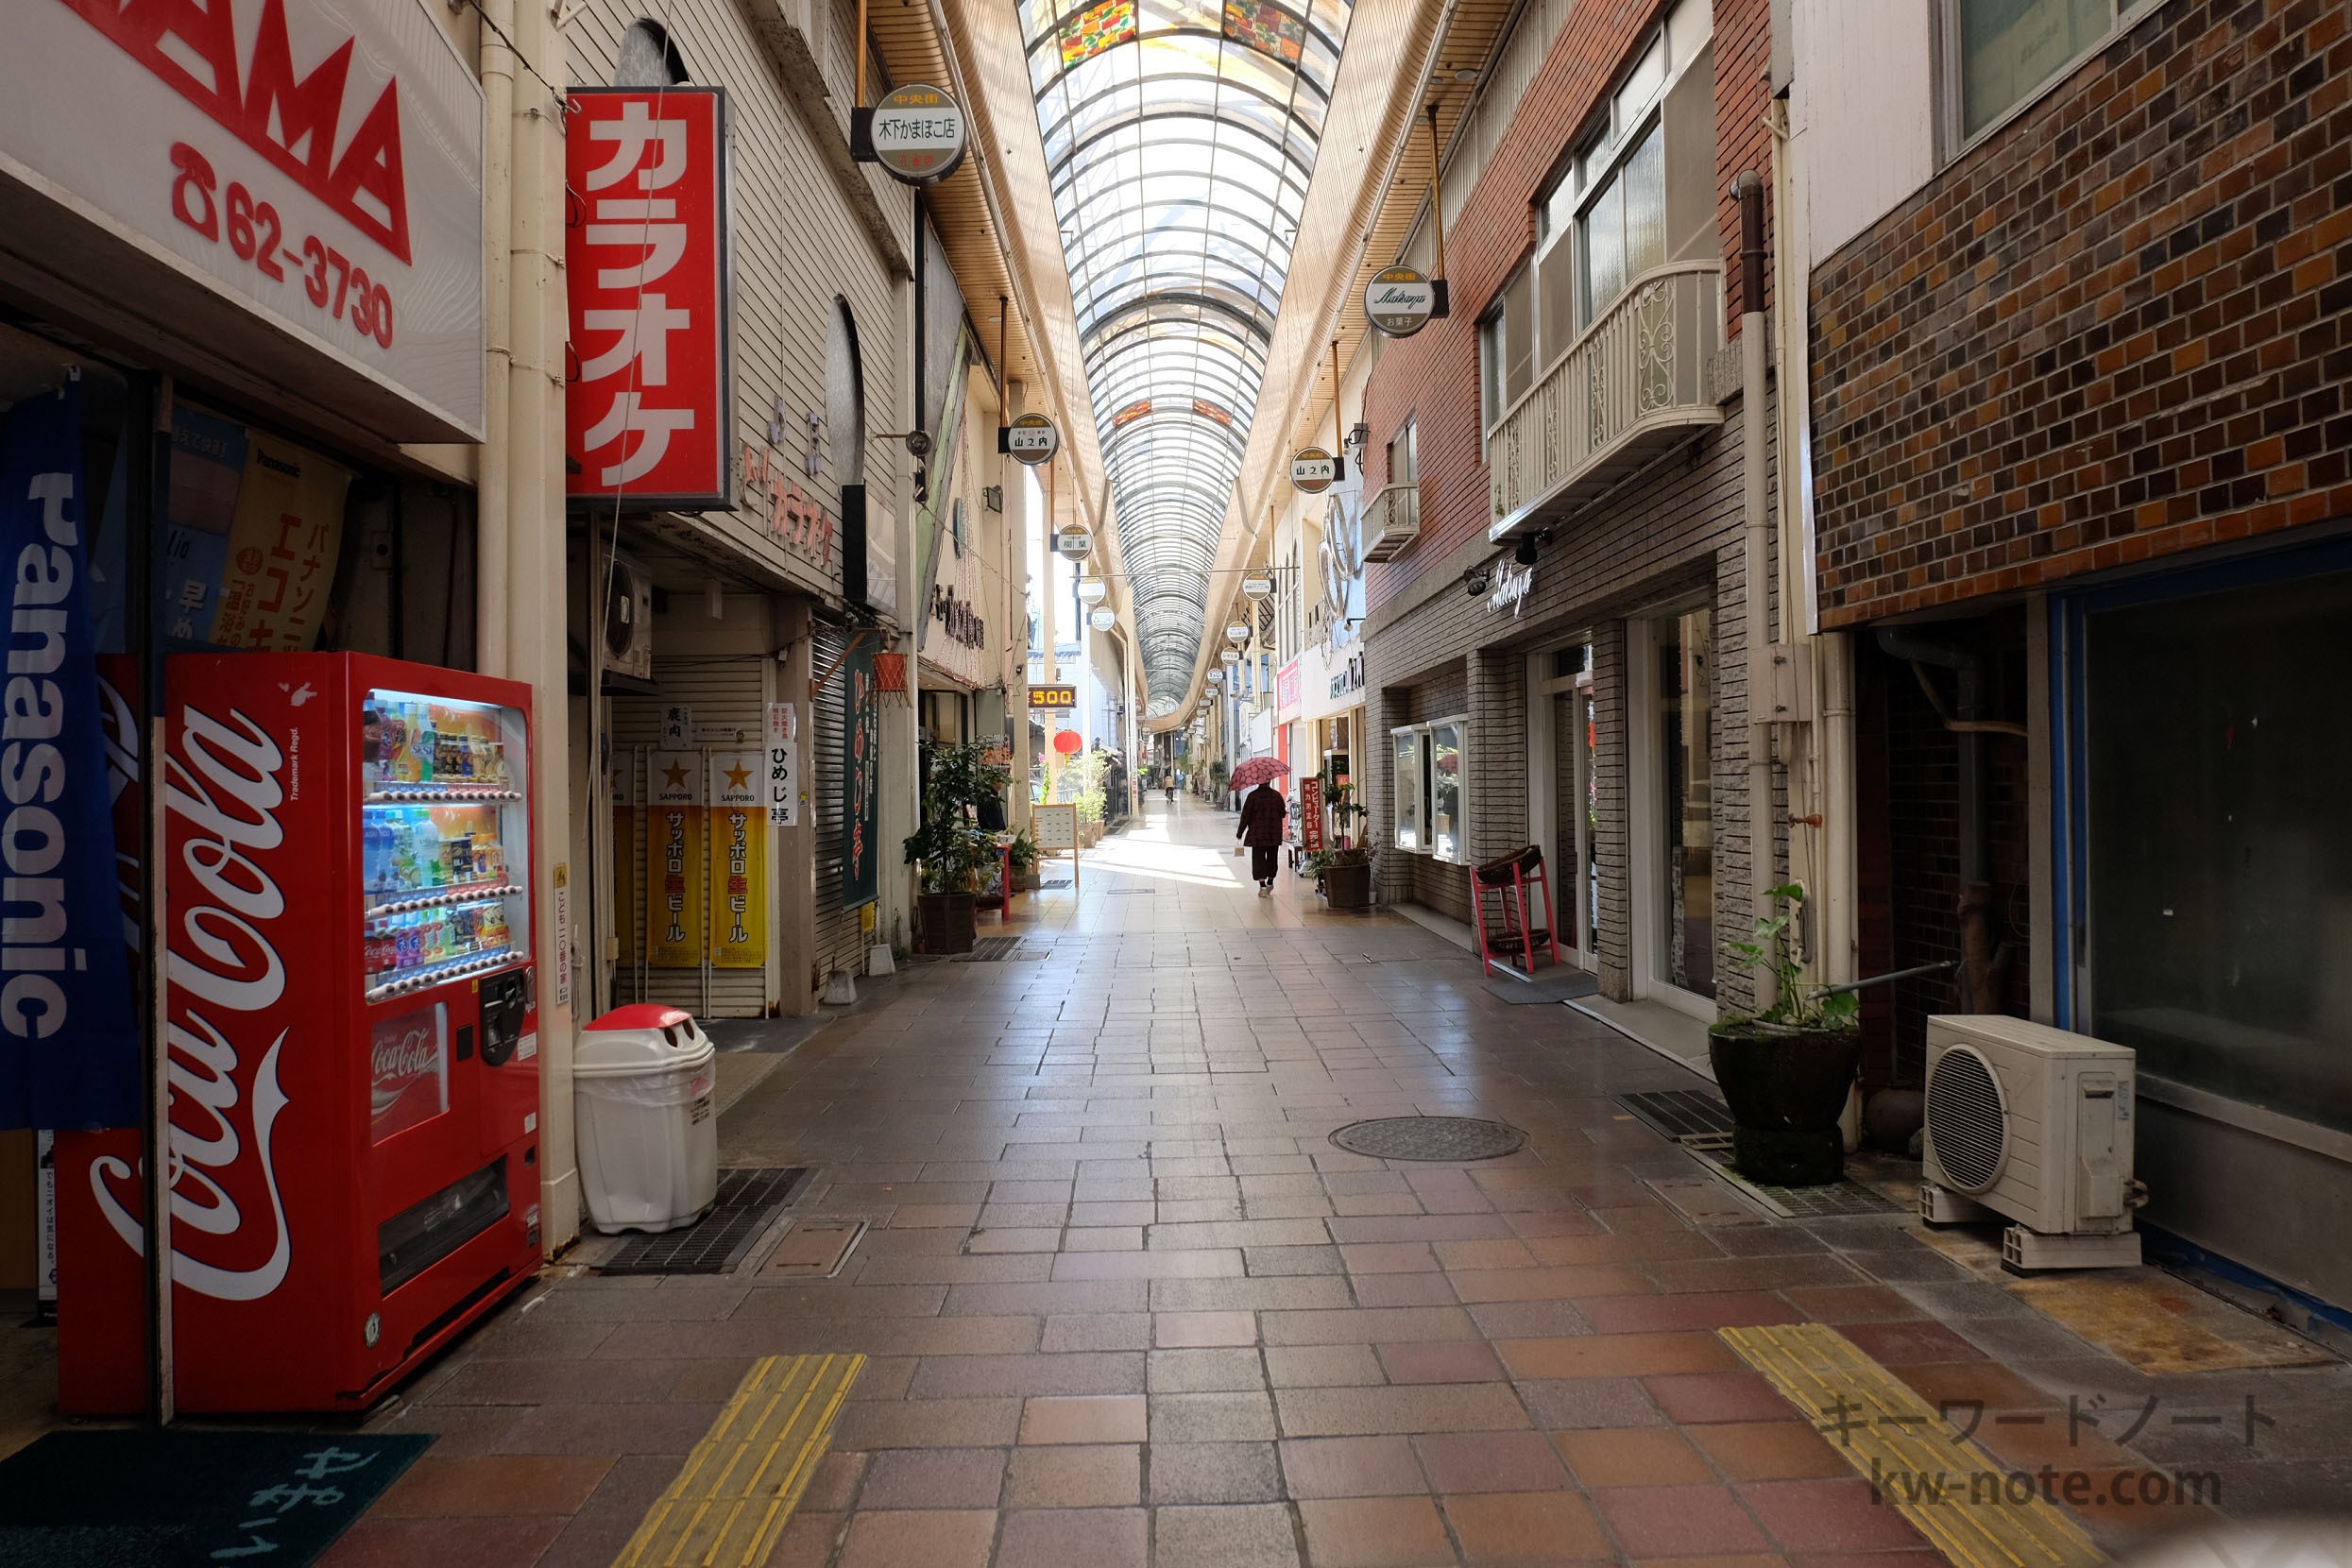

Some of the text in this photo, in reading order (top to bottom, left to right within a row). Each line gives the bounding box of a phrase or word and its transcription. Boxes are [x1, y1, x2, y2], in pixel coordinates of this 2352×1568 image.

[60, 0, 413, 266] AMA
[878, 117, 956, 141] 木下かまぼこ店
[227, 180, 394, 349] 62-3730
[580, 101, 695, 487] カラオケ
[1386, 316, 1413, 327] お菓子
[1014, 436, 1048, 447] 山之内
[1296, 464, 1330, 476] 山之内
[0, 470, 86, 1041] Panasonic
[666, 707, 681, 738] 鹿肉
[289, 726, 300, 802] Trademark Regd.
[658, 793, 692, 801] SAPPORO
[721, 793, 755, 802] SAPPORO
[770, 746, 789, 826] ひめじ亭
[852, 668, 865, 881] ひめじ亭
[1310, 780, 1321, 828] コンピューター
[664, 811, 686, 943] サッポロ生ビール
[727, 812, 748, 944] サッポロ生ビール
